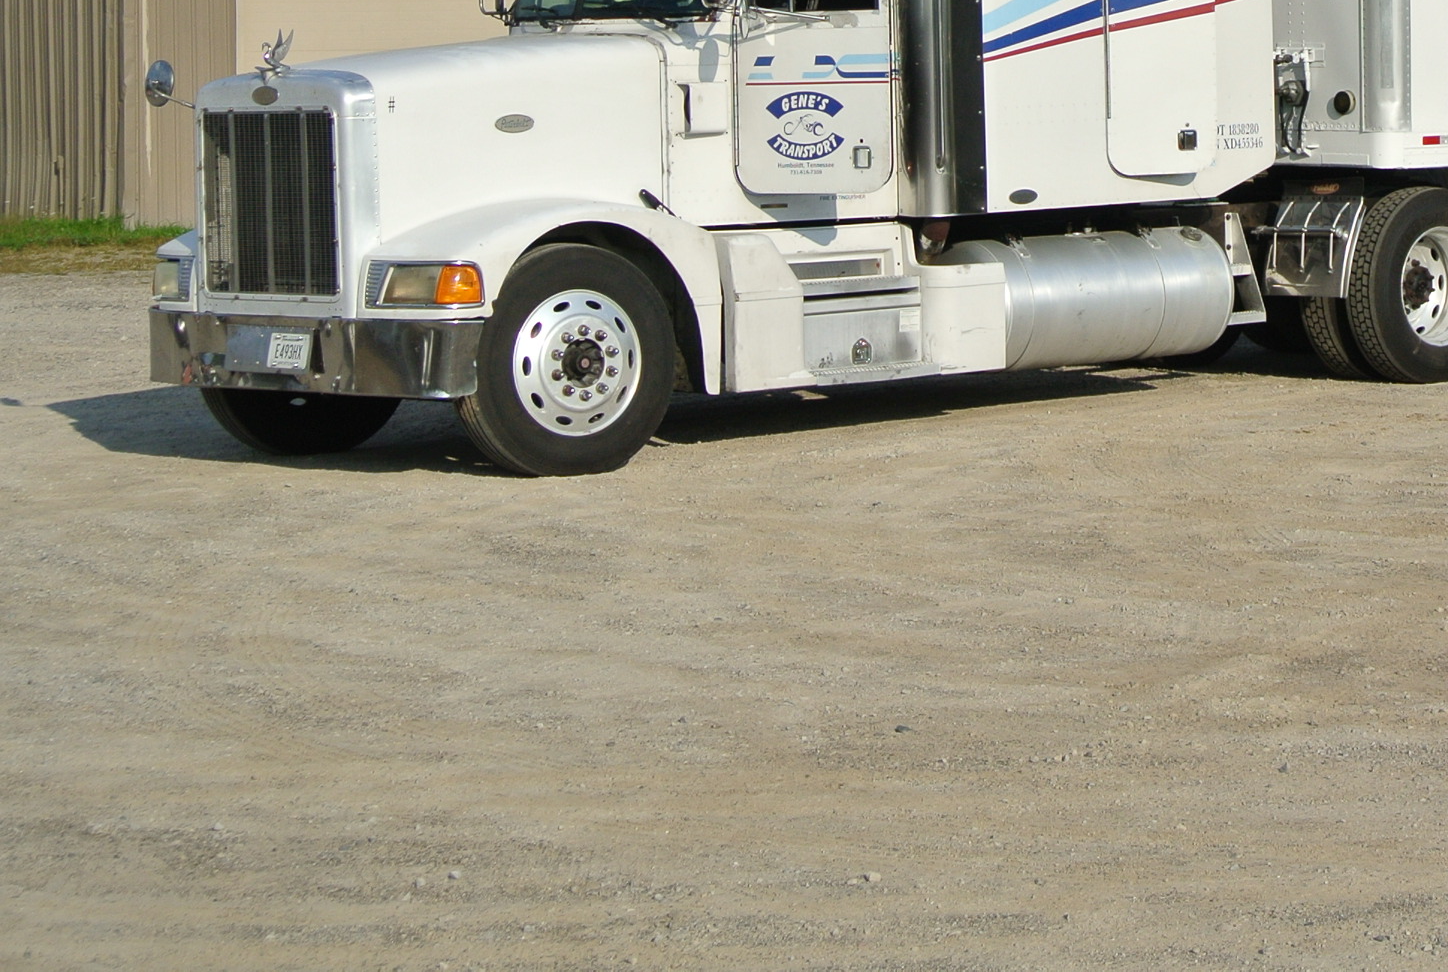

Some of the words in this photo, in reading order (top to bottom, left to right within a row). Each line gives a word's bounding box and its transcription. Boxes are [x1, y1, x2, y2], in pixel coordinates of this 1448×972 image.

[781, 94, 829, 112] GENE'S
[773, 135, 838, 158] TRANSPORT
[274, 343, 303, 360] E493HX
